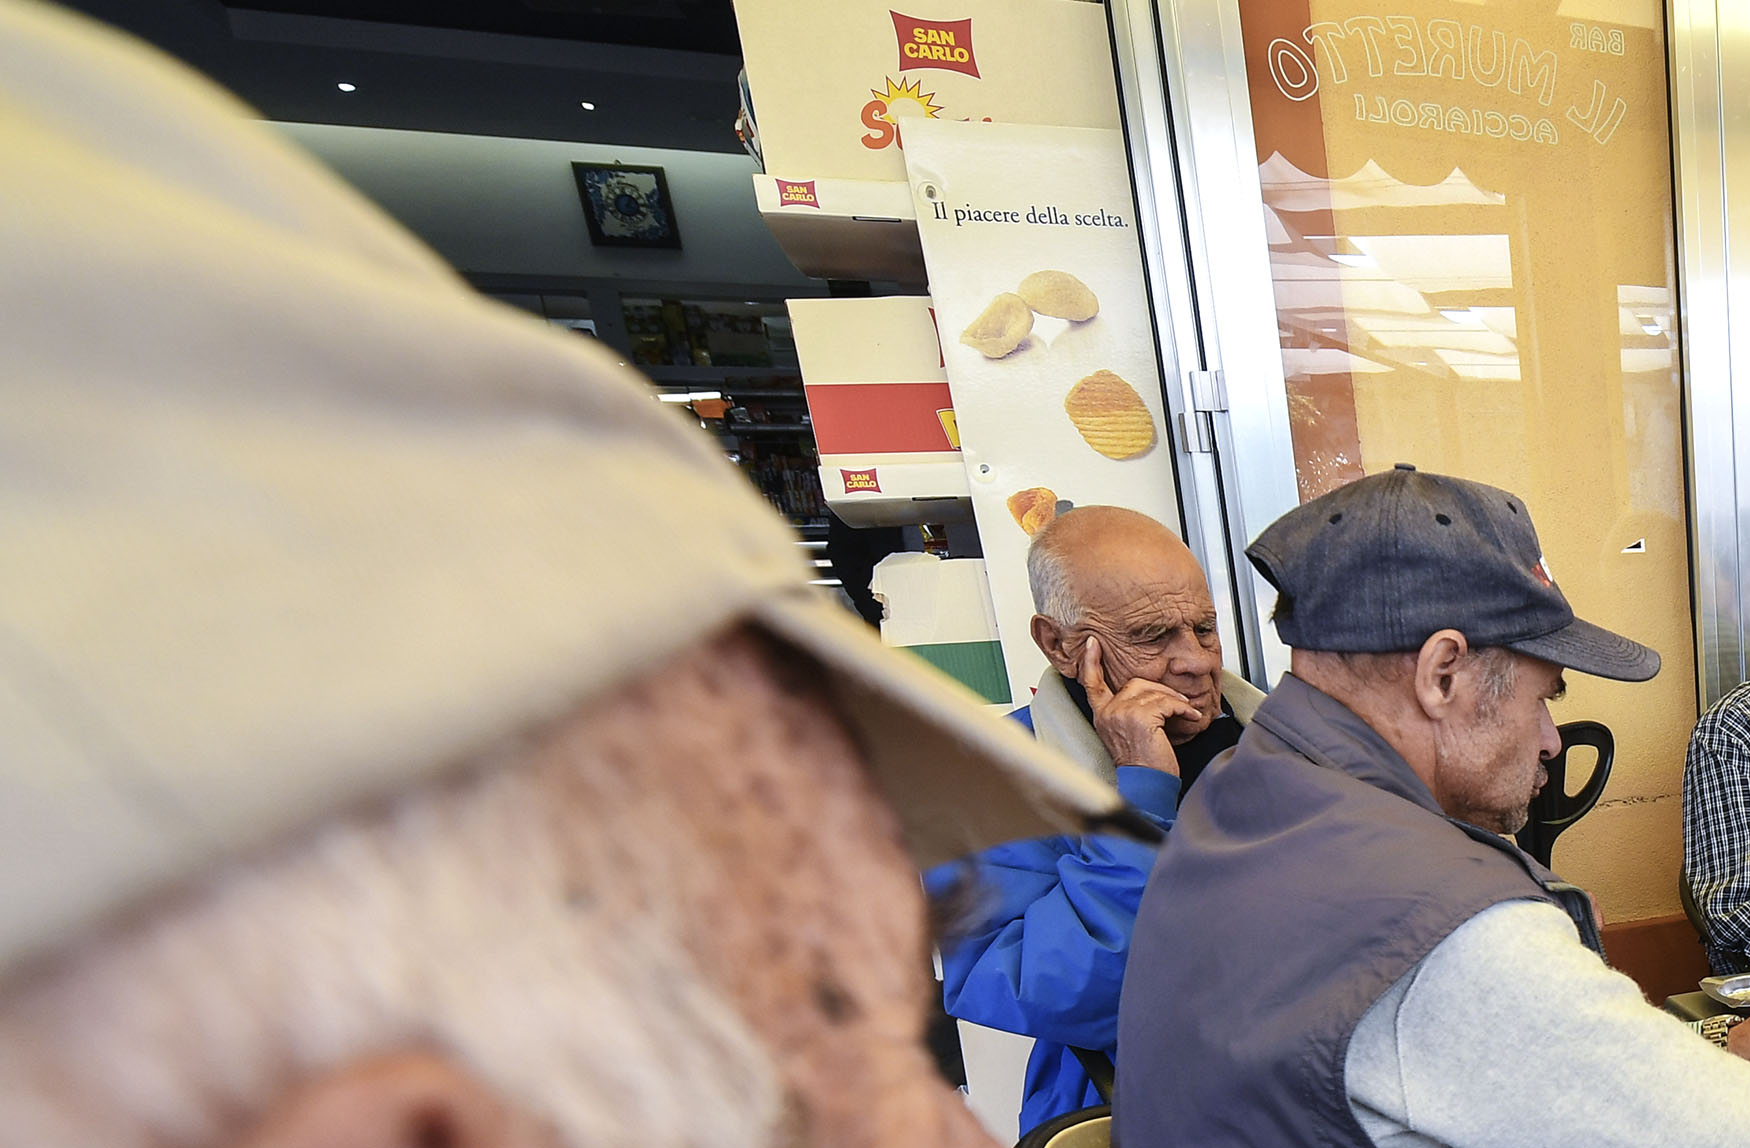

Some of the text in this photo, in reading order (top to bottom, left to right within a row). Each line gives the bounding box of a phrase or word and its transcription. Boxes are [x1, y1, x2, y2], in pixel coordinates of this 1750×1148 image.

[913, 27, 955, 46] SAN
[904, 42, 969, 63] CARLO
[786, 185, 807, 194] SAN
[782, 192, 815, 202] CARLO
[932, 201, 1129, 227] Il piacere della scelta.
[846, 480, 877, 488] CARLO
